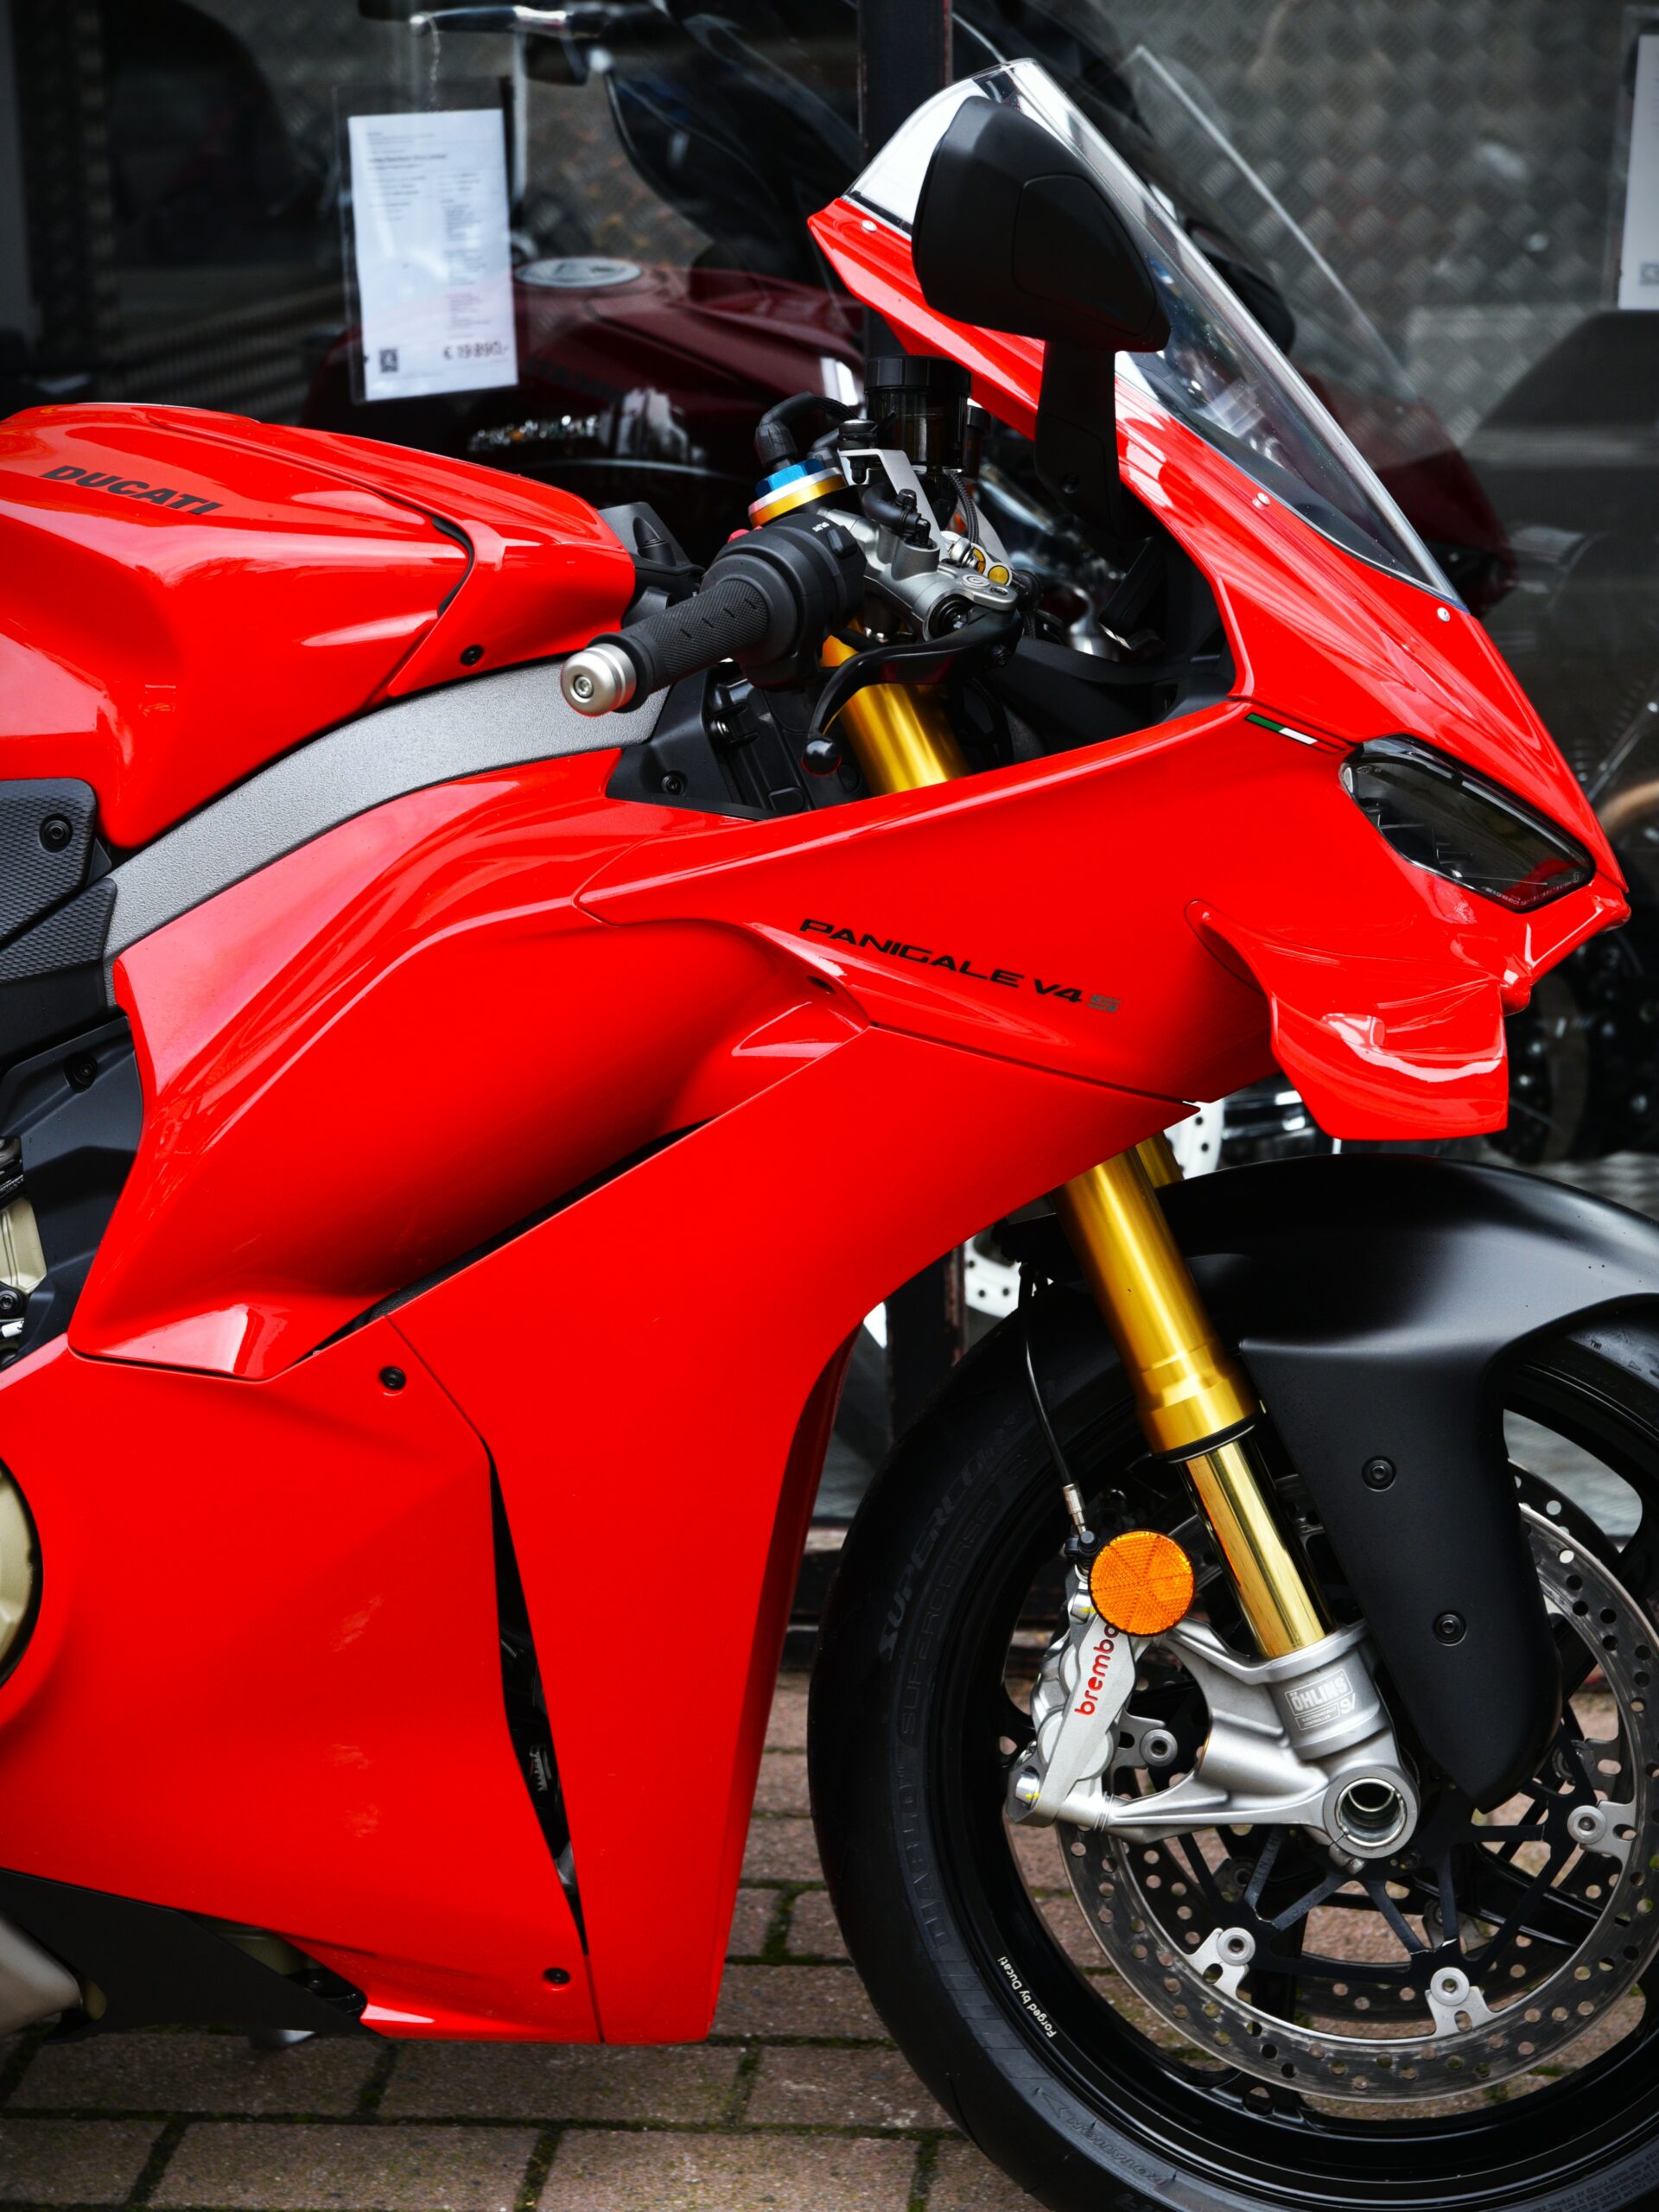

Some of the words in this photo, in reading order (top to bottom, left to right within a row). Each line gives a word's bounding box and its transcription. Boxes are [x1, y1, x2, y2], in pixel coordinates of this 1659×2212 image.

[40, 465, 225, 515] DUCATI
[799, 918, 1024, 988] PANIGALE
[1074, 1624, 1120, 1716] brembo
[1289, 1676, 1348, 1712] ÖHLINS
[997, 1956, 1022, 1990] Ducati
[1019, 1990, 1031, 2004] by
[1027, 2003, 1058, 2038] Forged
